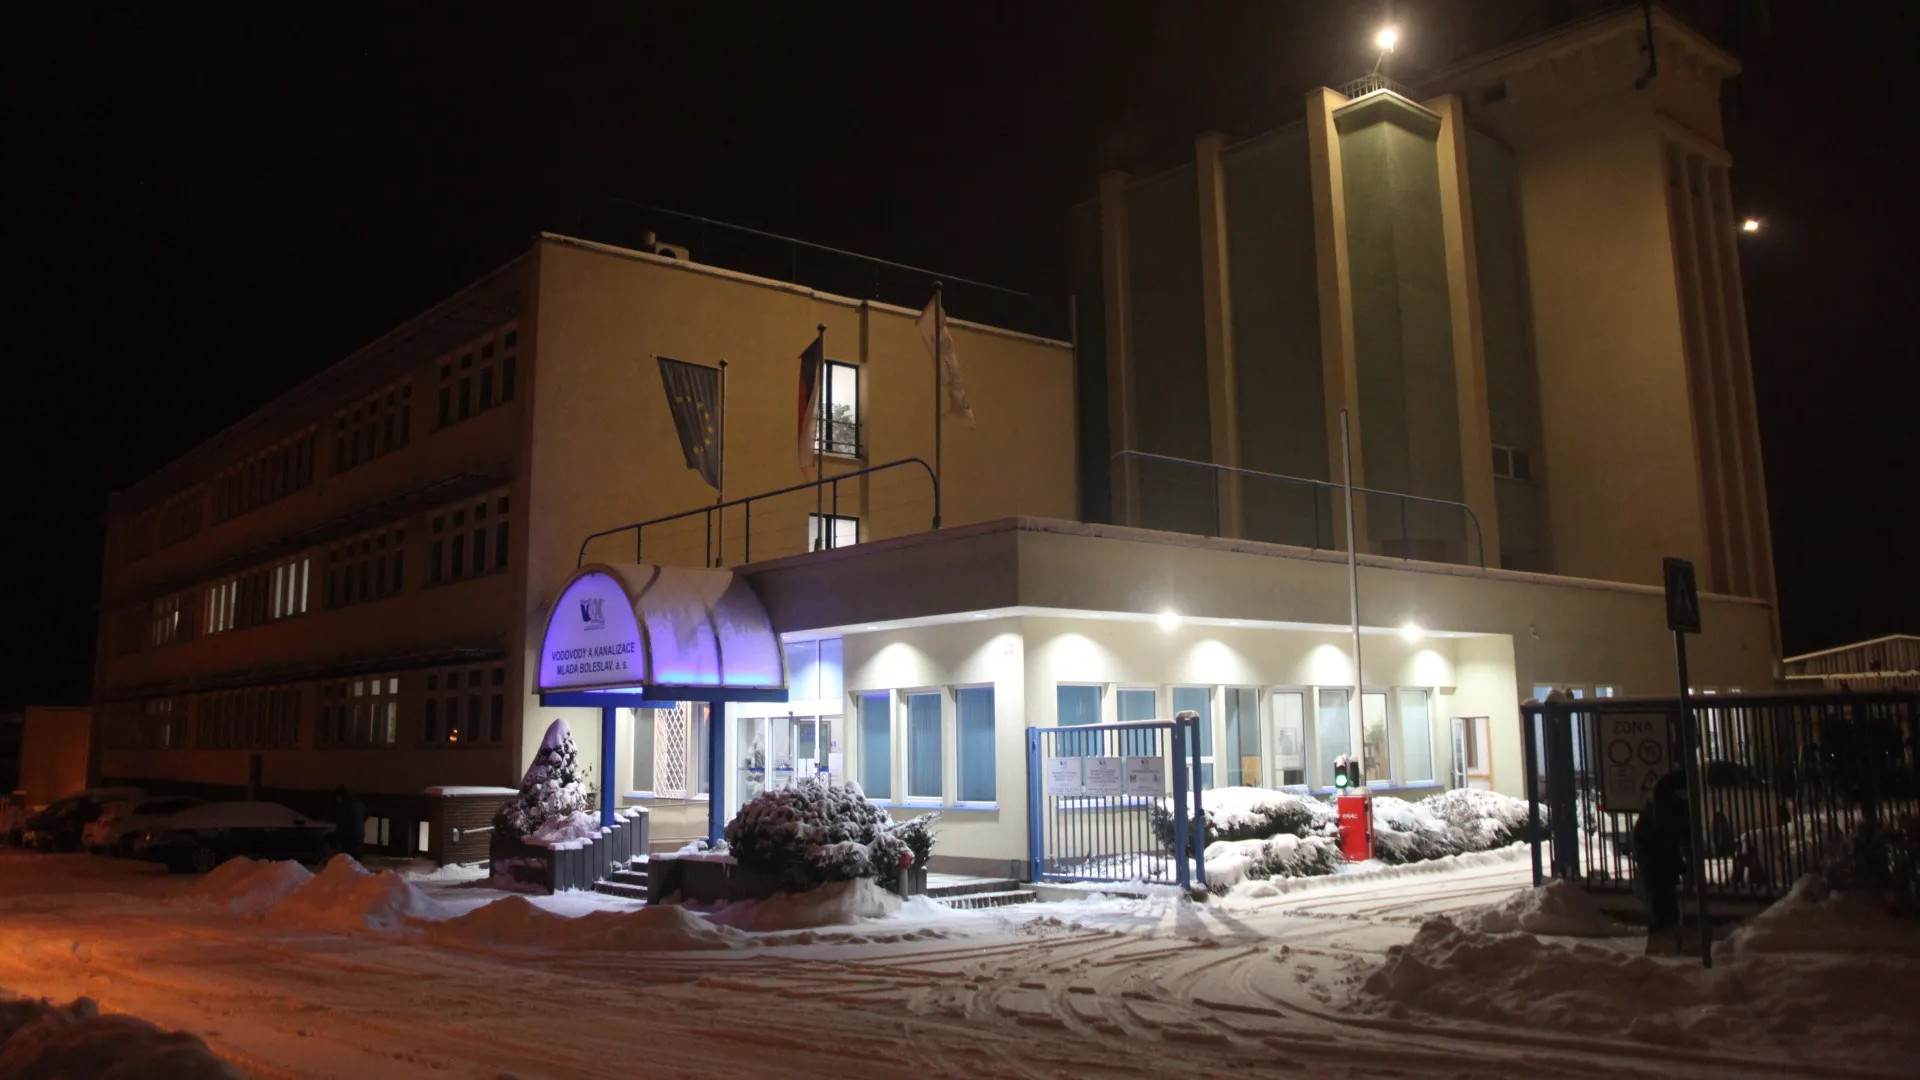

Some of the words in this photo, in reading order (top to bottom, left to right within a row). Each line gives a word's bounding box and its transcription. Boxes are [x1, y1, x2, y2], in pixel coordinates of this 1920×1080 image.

[552, 648, 587, 661] VODOVODY
[587, 648, 593, 658] A
[594, 642, 636, 657] KANALIZACE
[1613, 719, 1653, 734] ZONA
